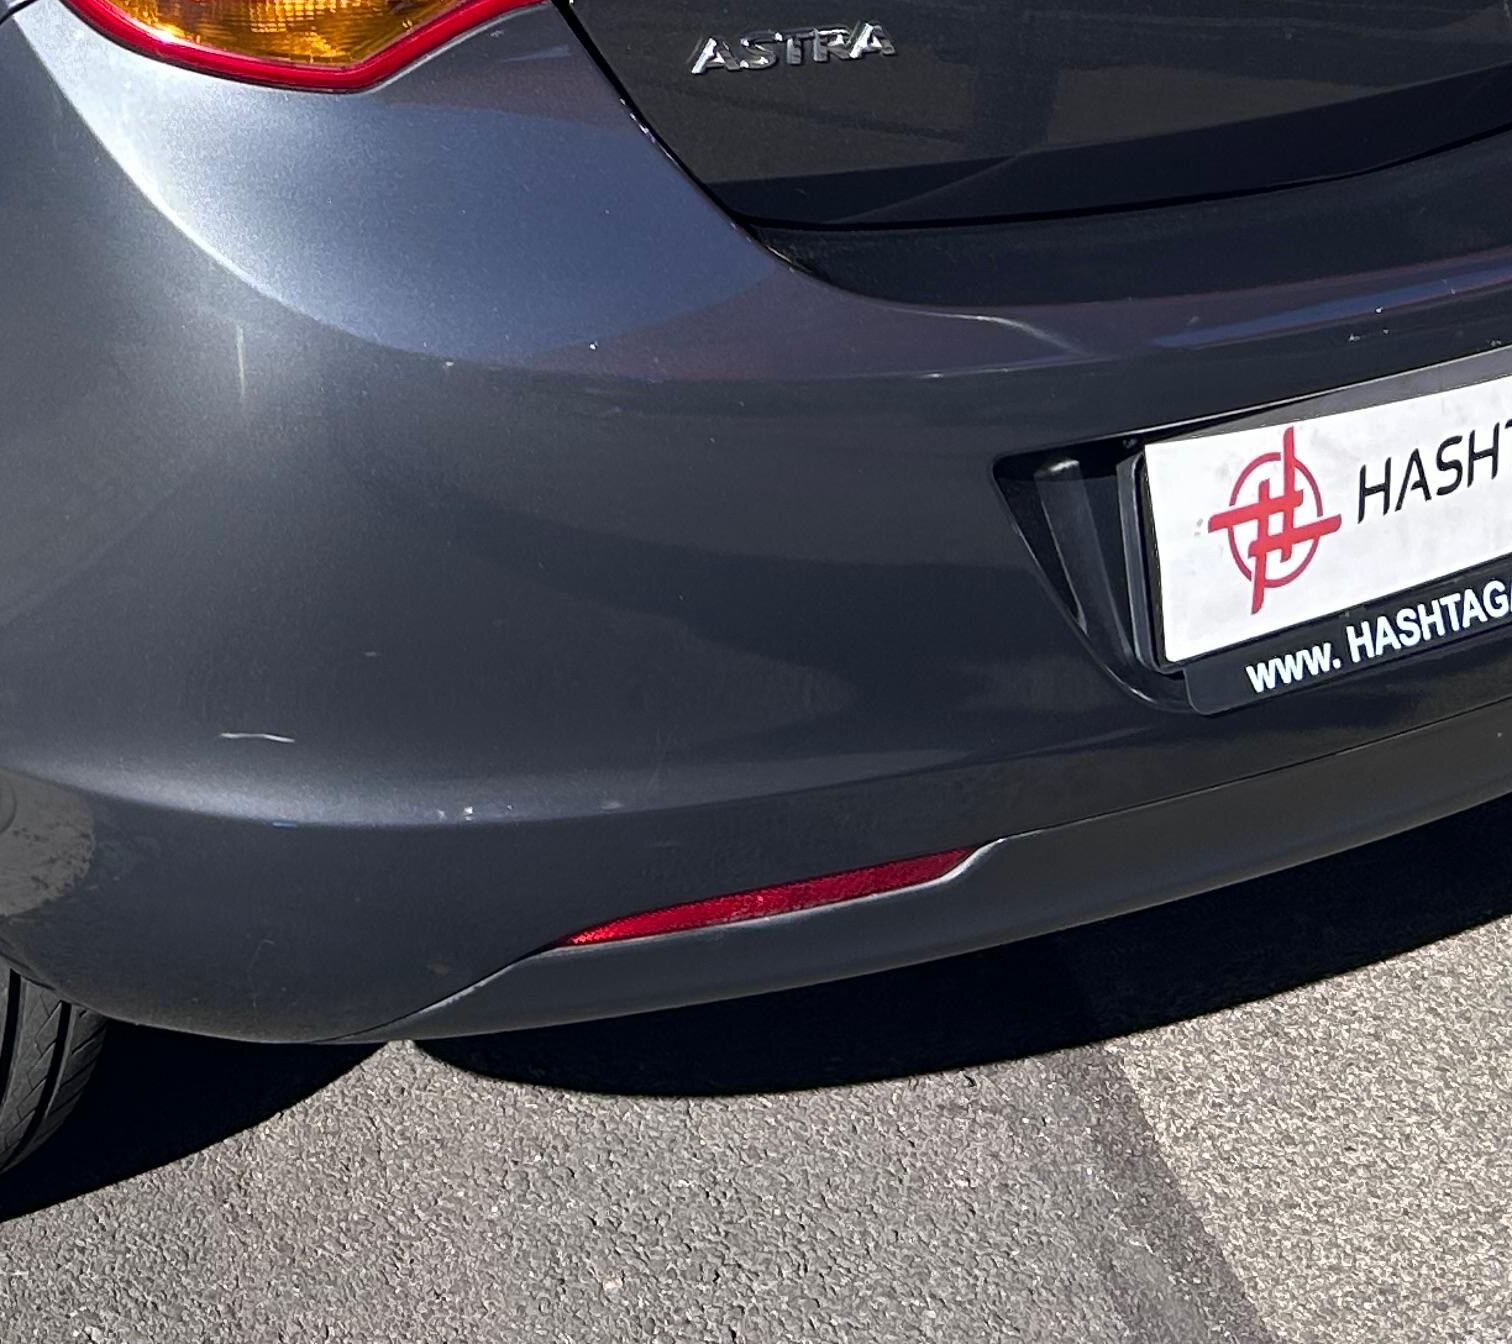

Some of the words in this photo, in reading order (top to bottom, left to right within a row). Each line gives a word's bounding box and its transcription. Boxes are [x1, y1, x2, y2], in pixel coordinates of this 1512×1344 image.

[688, 20, 896, 74] ASTRA
[1357, 418, 1512, 524] HASH
[1346, 579, 1512, 663] HASHTAG
